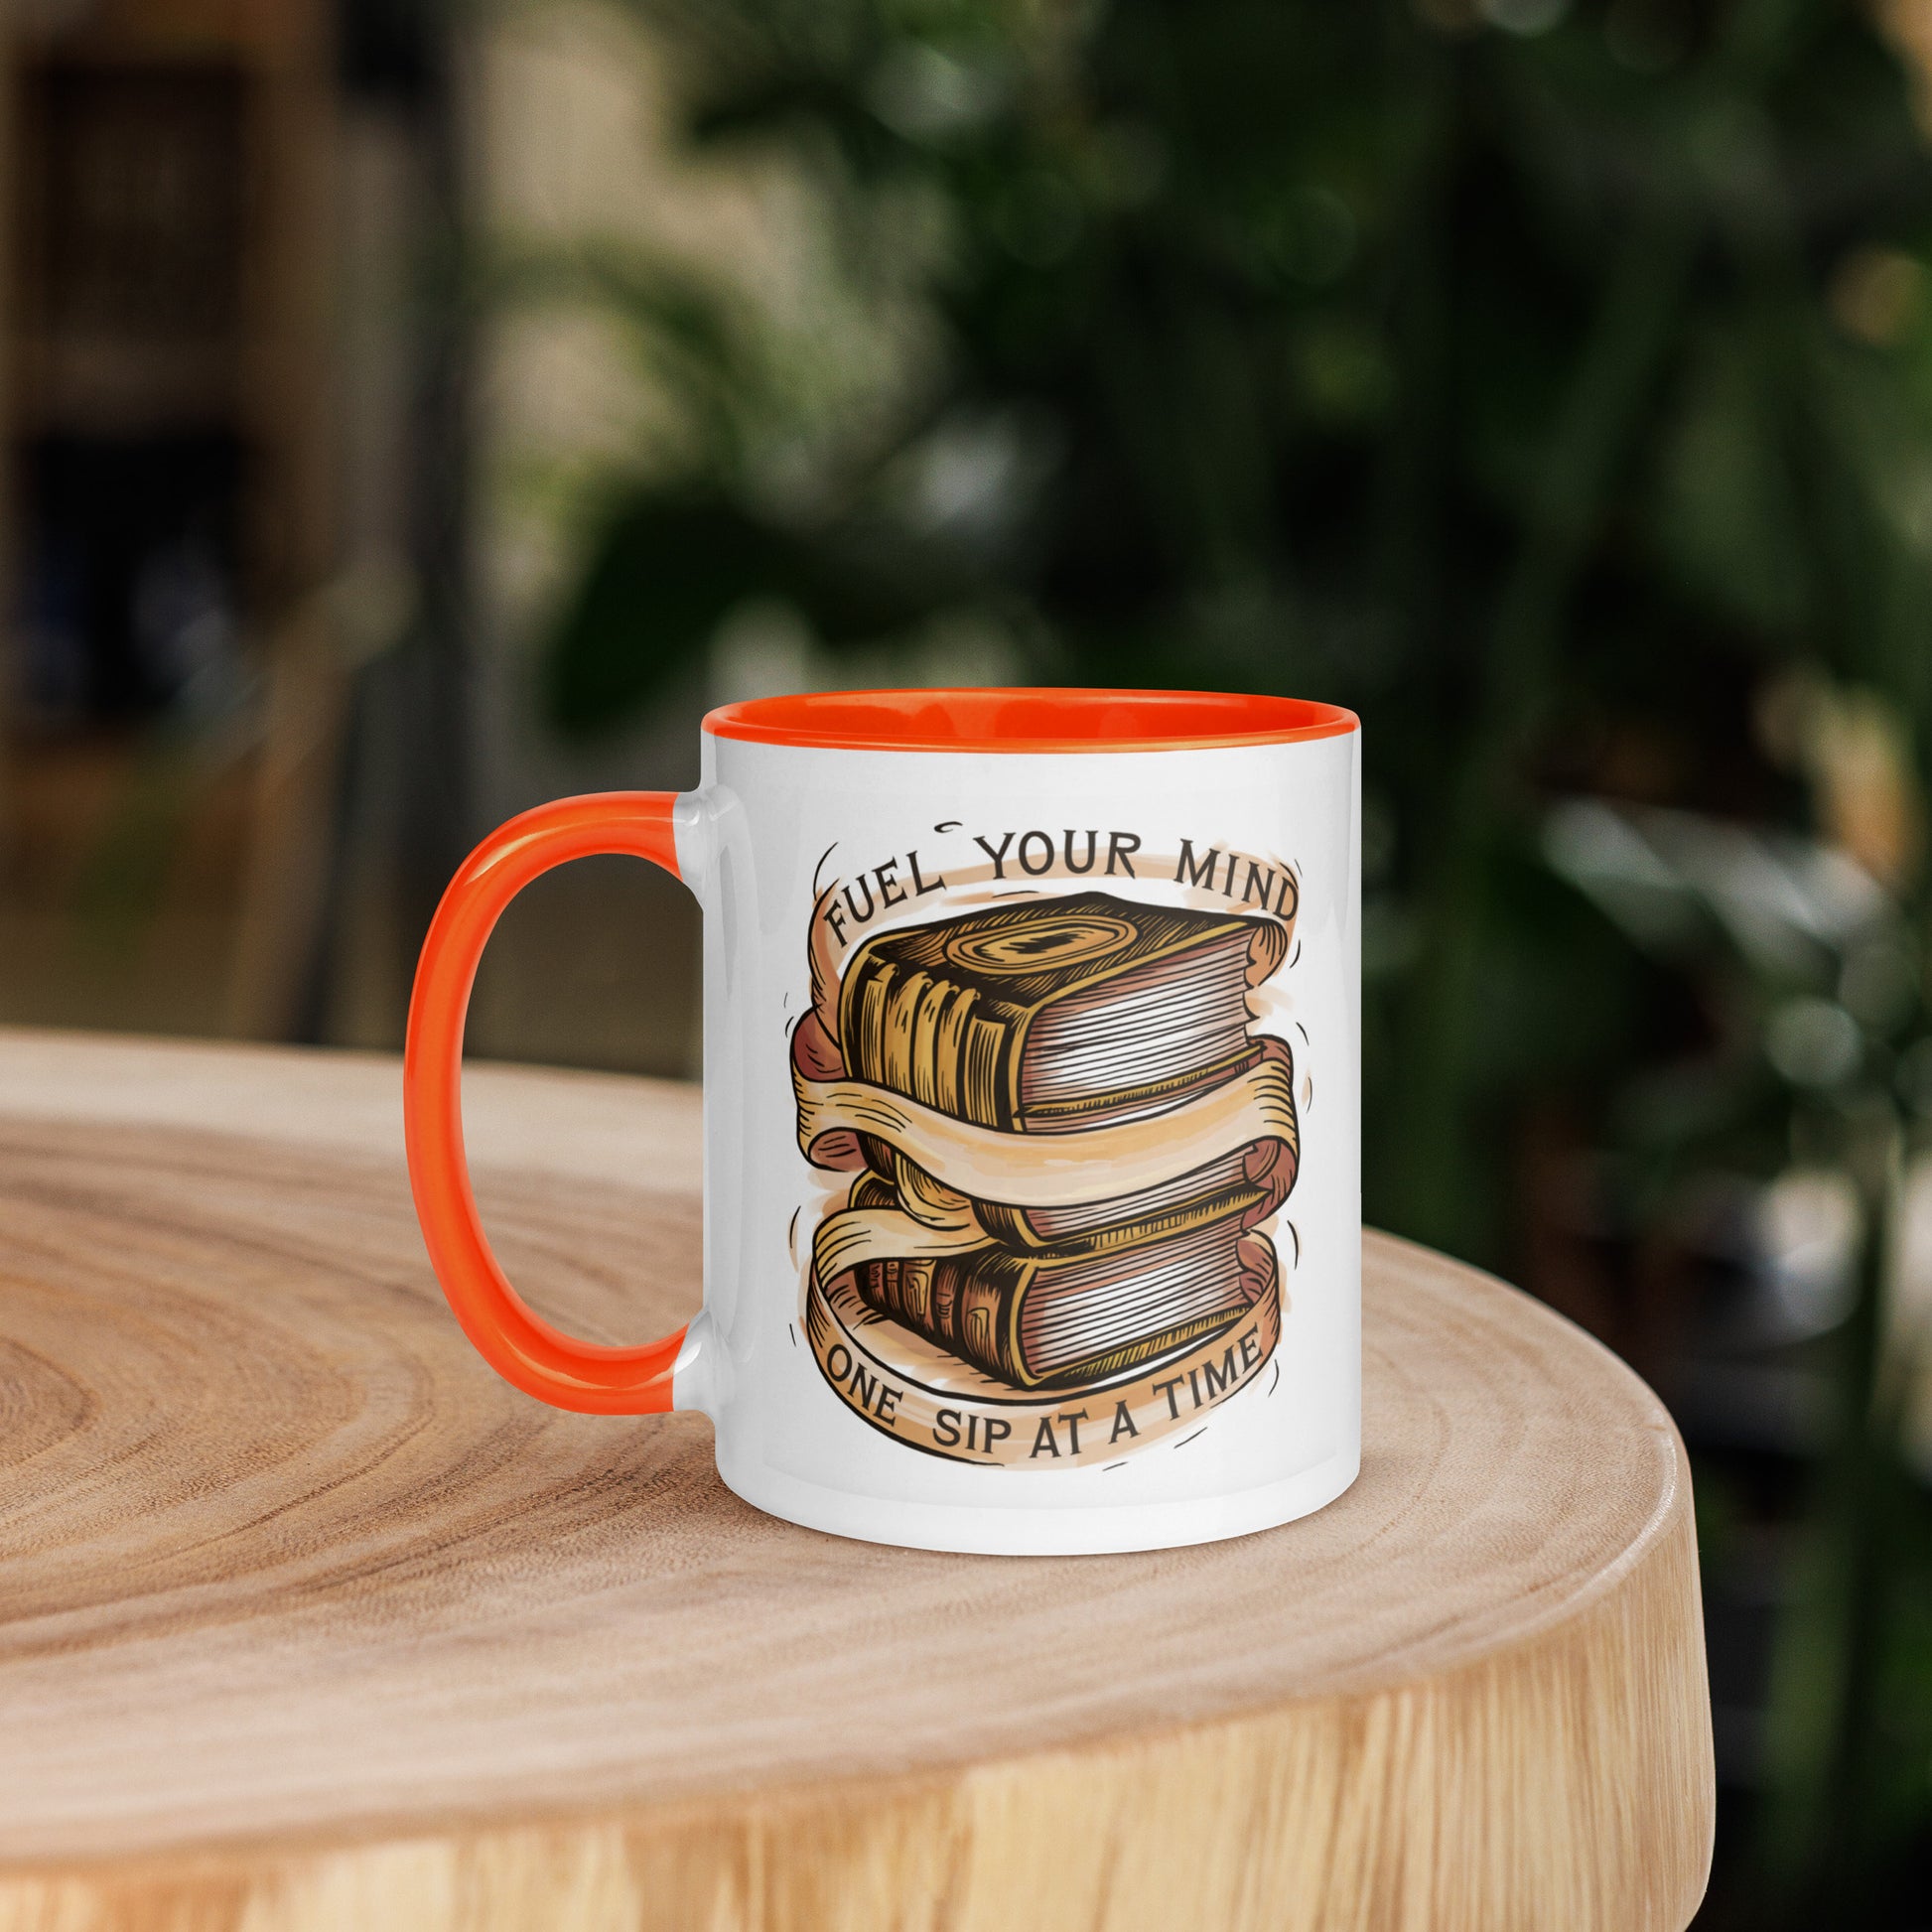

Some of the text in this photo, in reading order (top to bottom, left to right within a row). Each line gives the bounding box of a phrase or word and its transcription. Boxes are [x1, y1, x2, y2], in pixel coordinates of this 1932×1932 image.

[823, 829, 1298, 947] FUEL YOUR MIND
[826, 1324, 1264, 1458] ONE SIP AT A TIME
